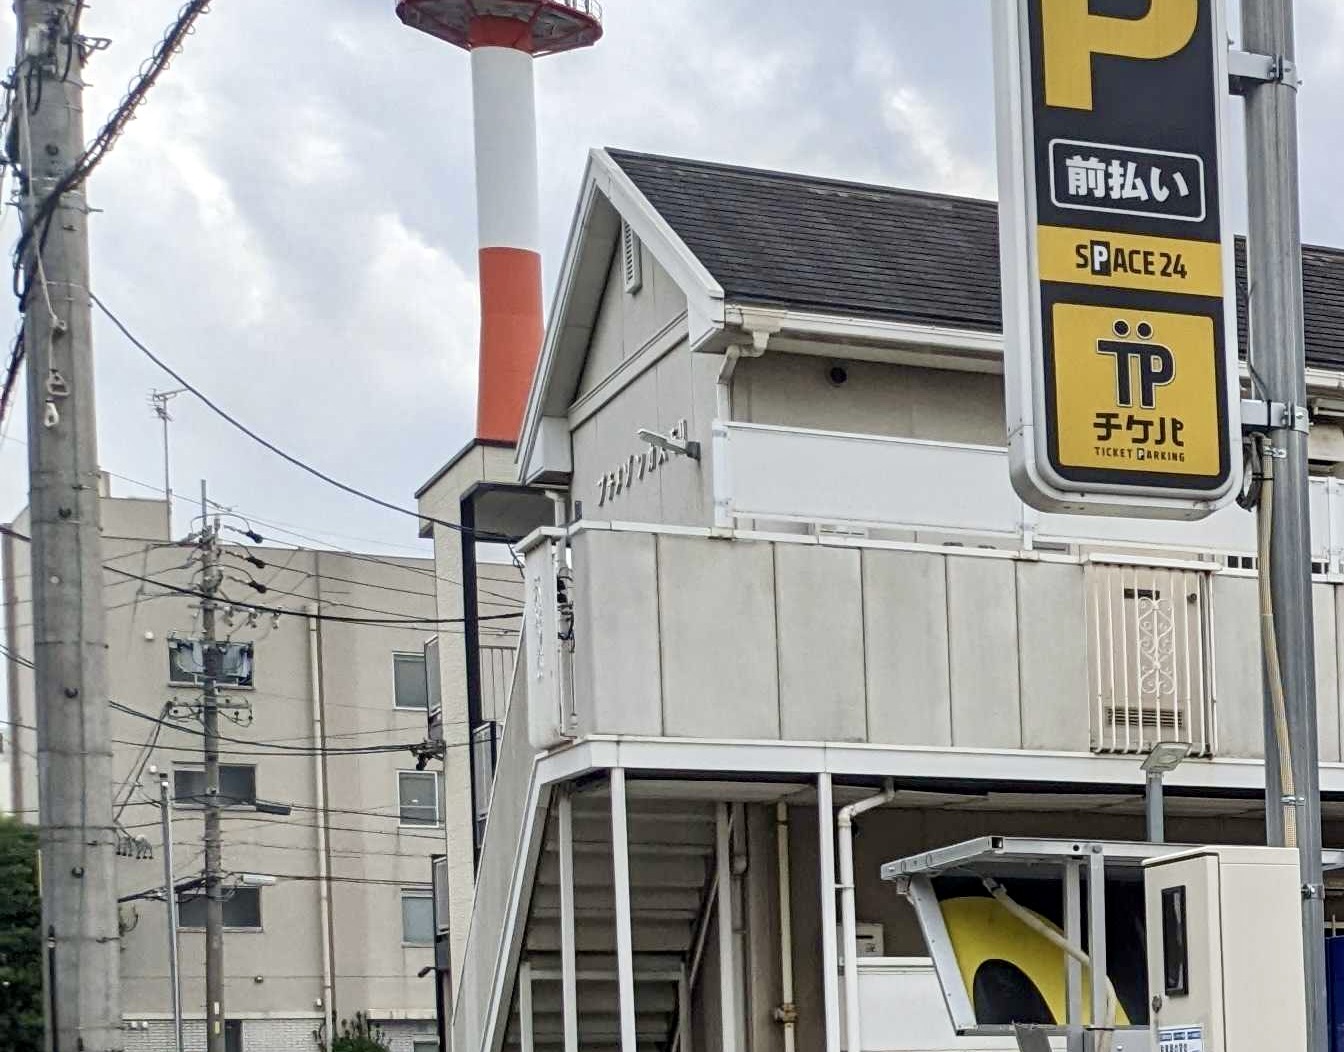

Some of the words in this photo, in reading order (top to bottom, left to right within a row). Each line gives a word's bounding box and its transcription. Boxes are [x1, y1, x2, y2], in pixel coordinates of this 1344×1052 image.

[1041, 0, 1199, 111] P
[1065, 154, 1190, 203] 前払い
[1075, 240, 1155, 276] SPACE
[1160, 250, 1188, 279] 24
[1093, 412, 1185, 447] チケパ
[1094, 446, 1134, 459] TICKET
[1136, 447, 1185, 462] PARKING
